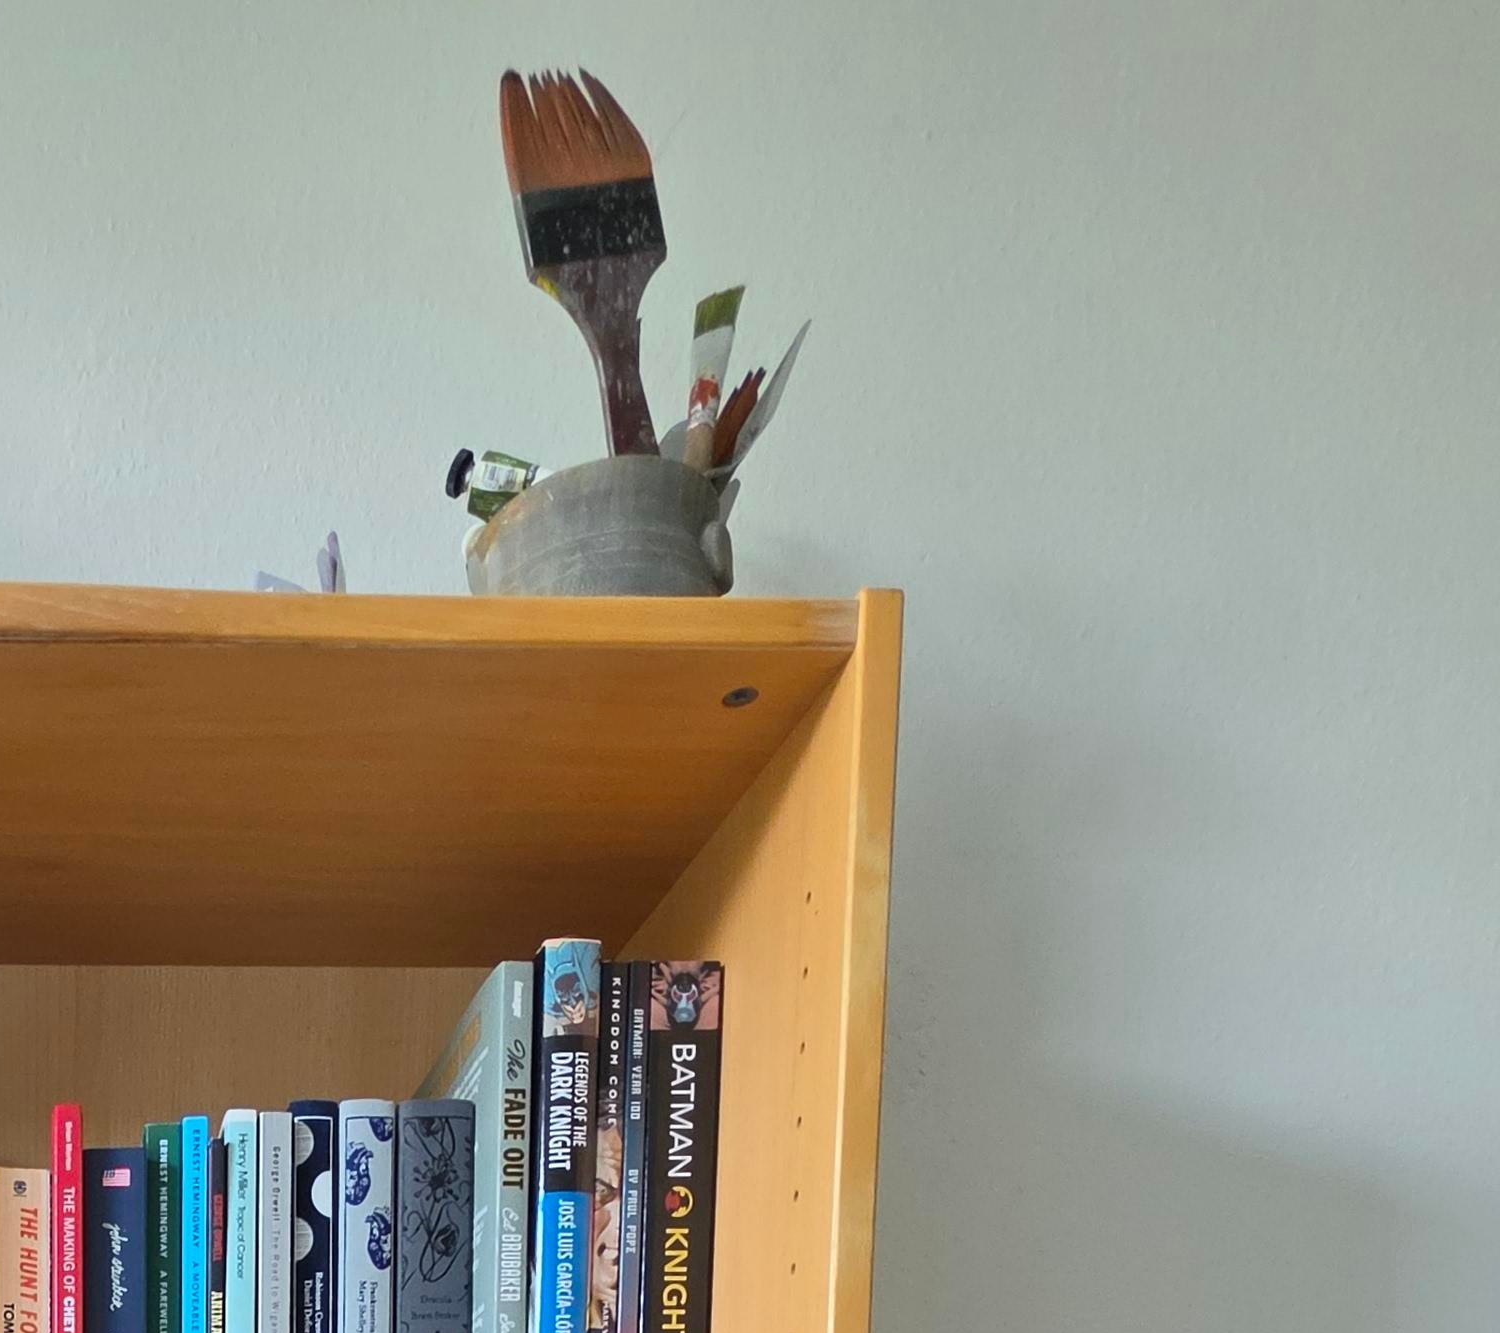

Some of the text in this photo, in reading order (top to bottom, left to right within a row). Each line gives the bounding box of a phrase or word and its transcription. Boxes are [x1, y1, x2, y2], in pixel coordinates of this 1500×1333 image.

[503, 1088, 526, 1190] FADE OUT
[549, 1052, 573, 1171] DARK KNIGHT
[572, 1052, 590, 1148] LEGENDS OF THE
[668, 1044, 697, 1178] BATMAN
[19, 1207, 38, 1241] THE
[19, 1248, 38, 1303] HUNT
